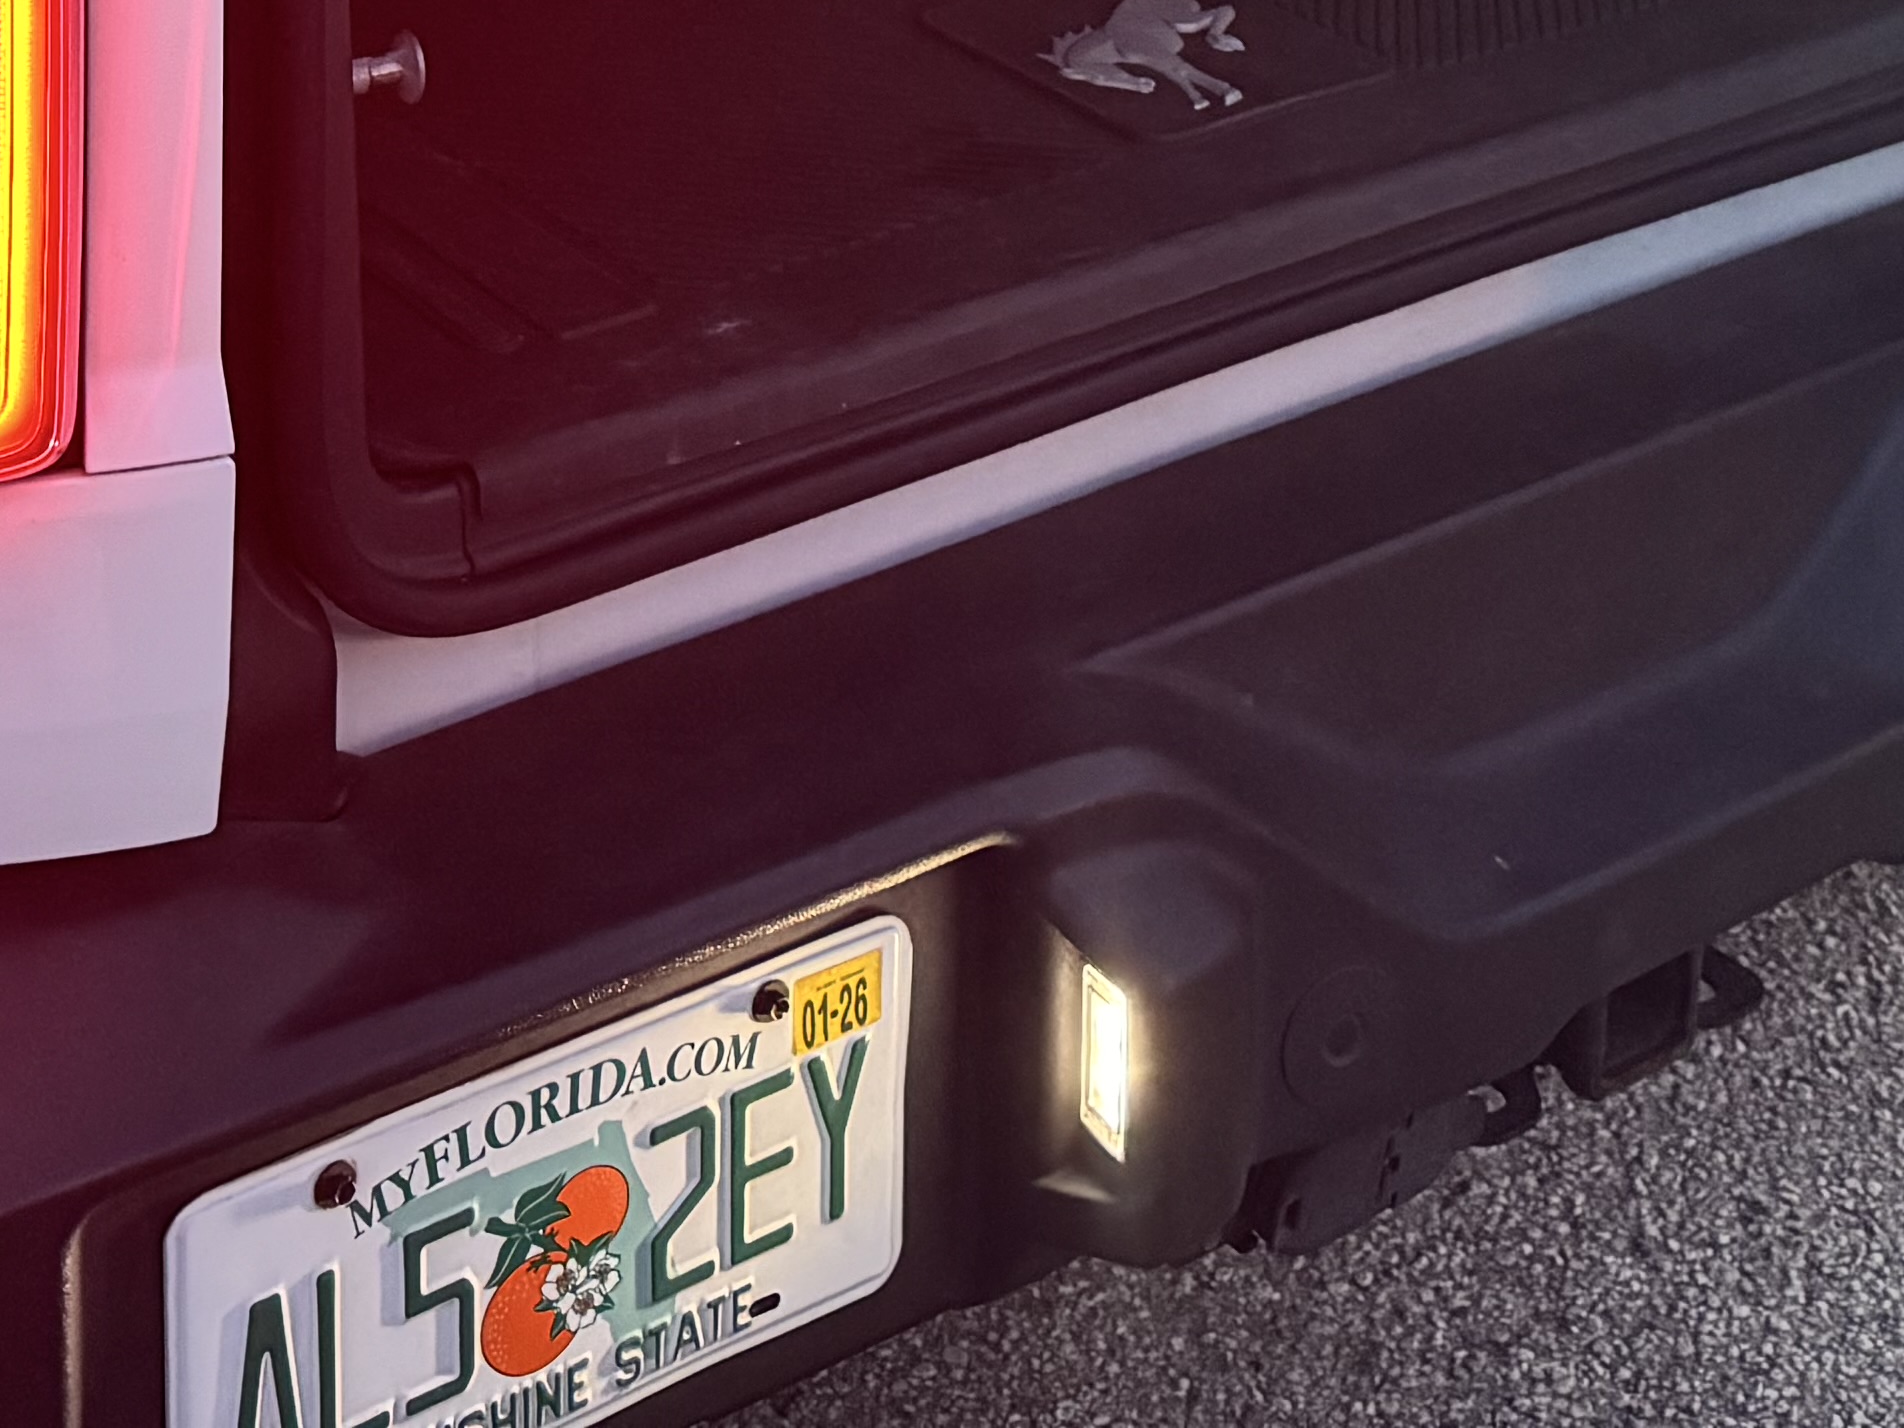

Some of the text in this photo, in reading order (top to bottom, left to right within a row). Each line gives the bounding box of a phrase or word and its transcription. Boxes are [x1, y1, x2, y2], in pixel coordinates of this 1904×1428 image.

[802, 976, 868, 1050] 01-26
[351, 1031, 762, 1239] MYFLORIDA.COM
[648, 1035, 870, 1305] 2EY
[614, 1282, 753, 1388] STATE
